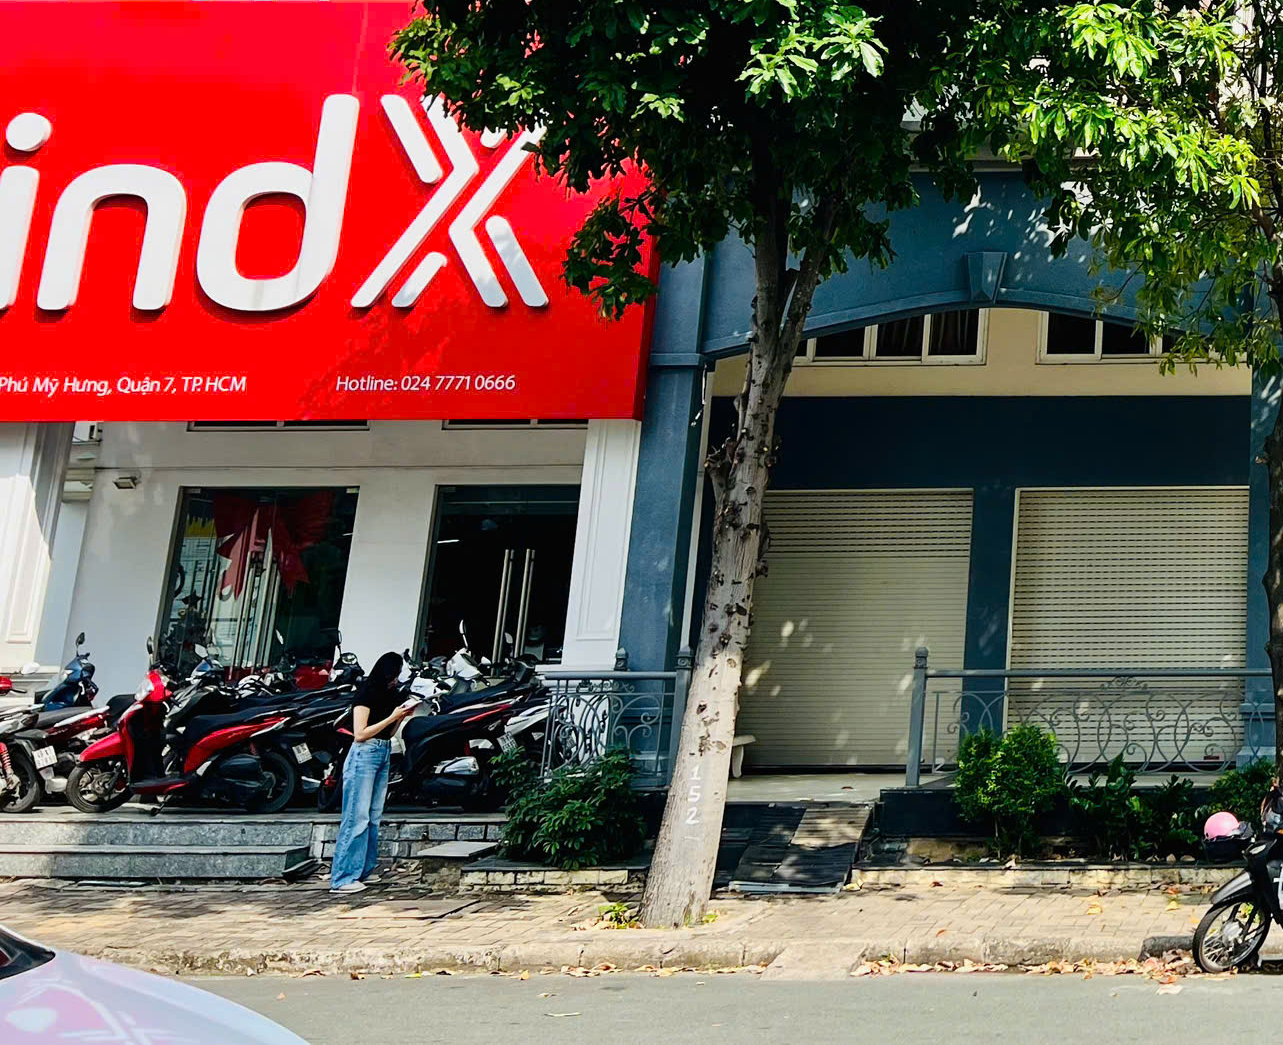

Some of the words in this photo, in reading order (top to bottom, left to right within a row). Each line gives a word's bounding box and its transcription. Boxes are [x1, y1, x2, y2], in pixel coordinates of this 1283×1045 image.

[0, 376, 28, 392] Phú
[33, 376, 59, 397] Mỹ
[63, 376, 112, 396] Hưng,
[117, 376, 160, 395] Quận
[163, 376, 177, 394] 7,
[336, 375, 398, 391] Hotline:
[401, 375, 431, 391] 024
[435, 375, 471, 391] 7771
[474, 374, 516, 391] 0666
[685, 764, 702, 825] 152
